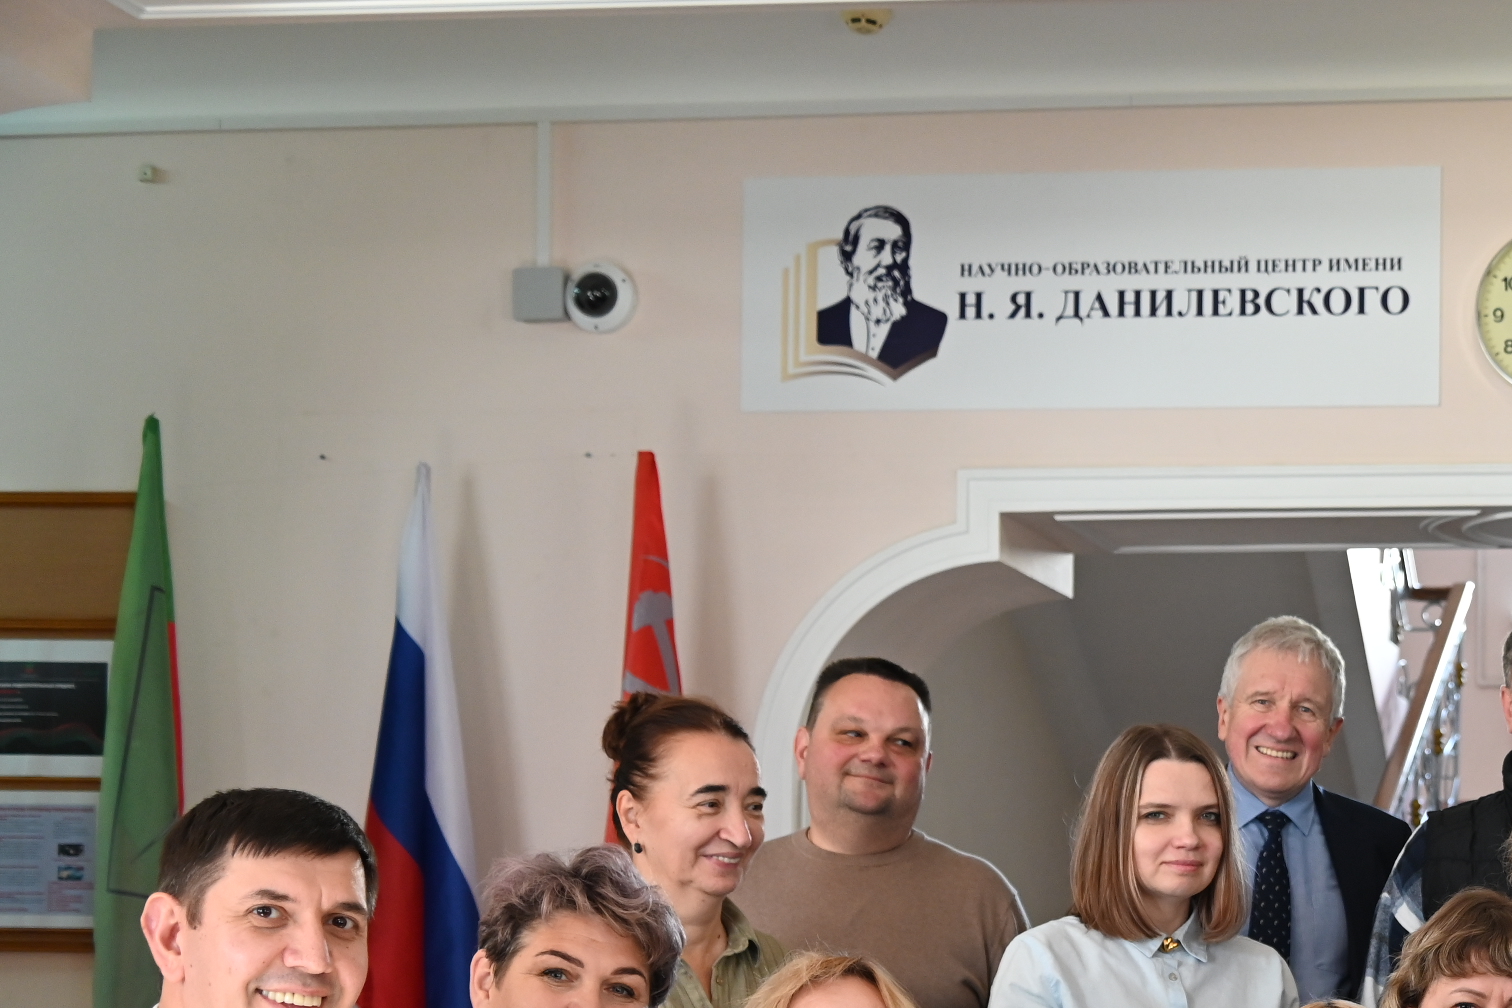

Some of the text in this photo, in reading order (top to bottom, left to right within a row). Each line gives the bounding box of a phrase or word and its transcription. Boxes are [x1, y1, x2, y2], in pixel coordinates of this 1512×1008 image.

[959, 256, 1402, 277] НАУЧНО-ОБРАЗОВАТЕЛЬНЫЙ ЦЕНТР ИМЕНИ
[957, 286, 1410, 325] Н. Я. ДАНИЛЕВСКОГО
[1492, 308, 1504, 323] 9
